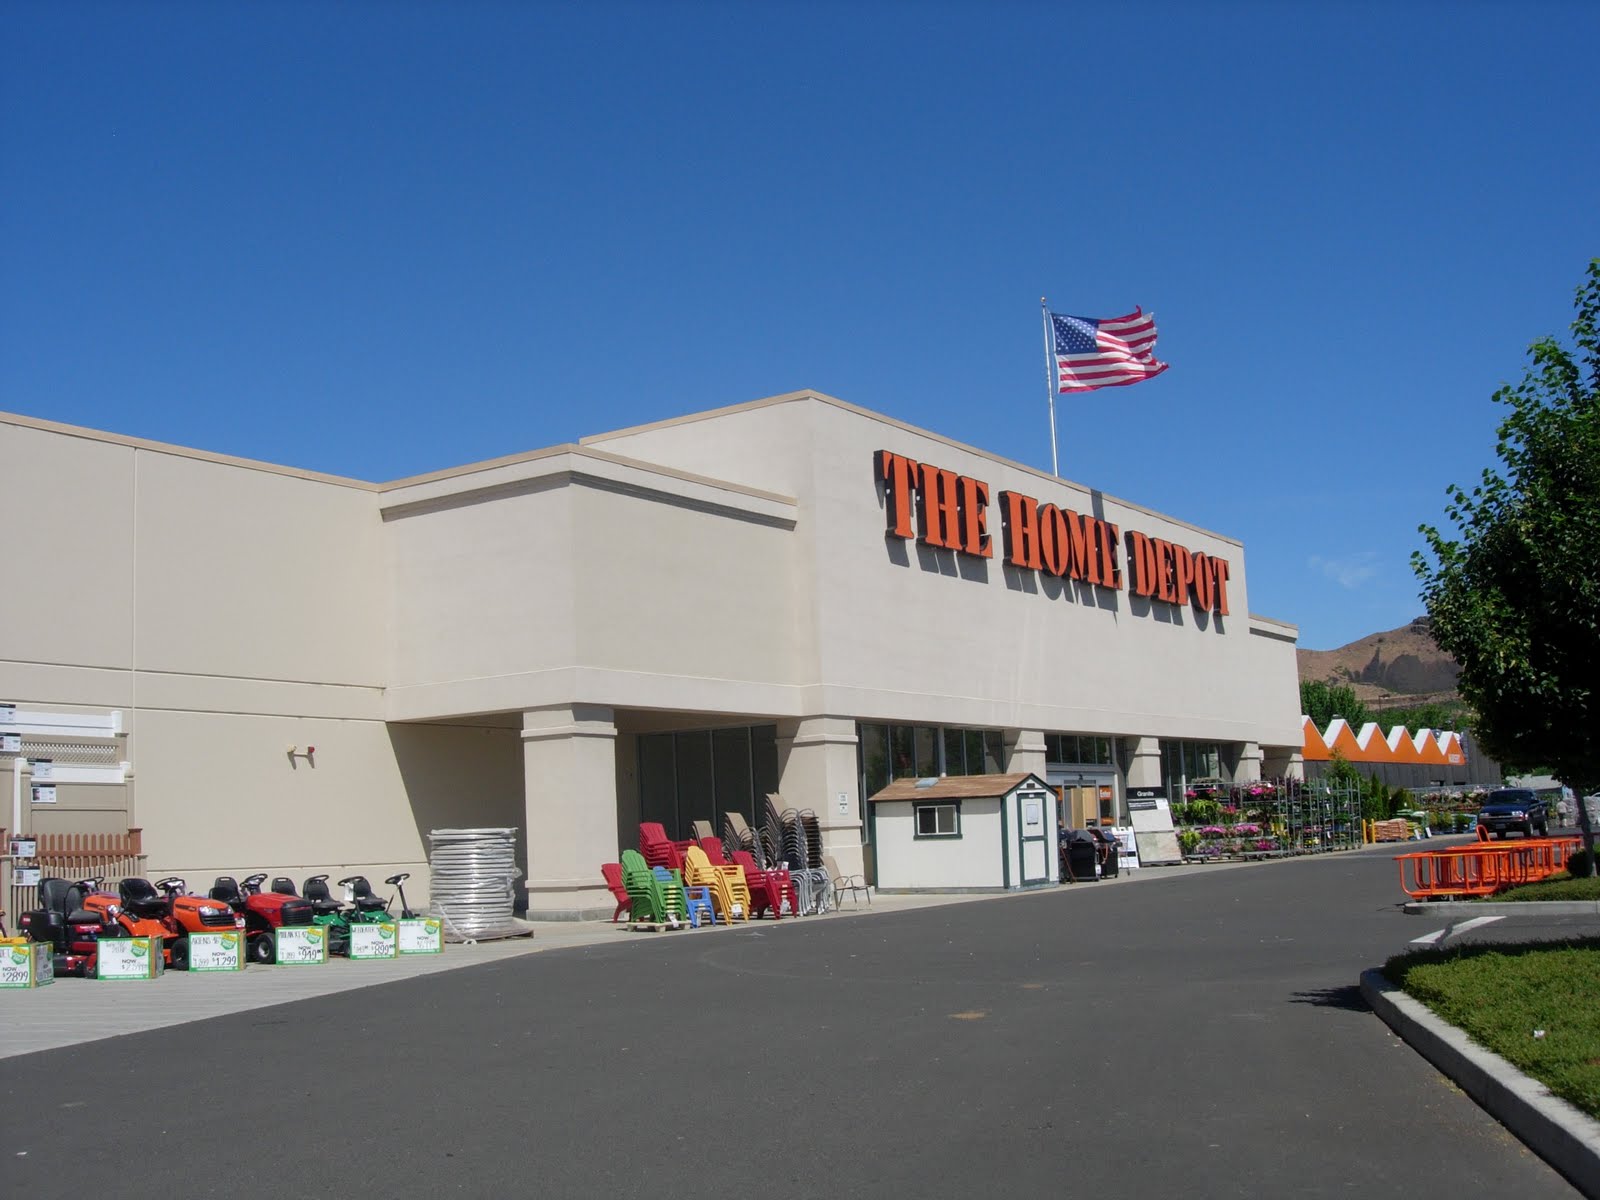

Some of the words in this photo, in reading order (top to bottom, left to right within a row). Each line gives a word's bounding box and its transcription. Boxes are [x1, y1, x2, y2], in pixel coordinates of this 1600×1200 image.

[875, 450, 993, 559] THE
[1000, 490, 1123, 590] HOME
[1126, 530, 1230, 617] DEPOT
